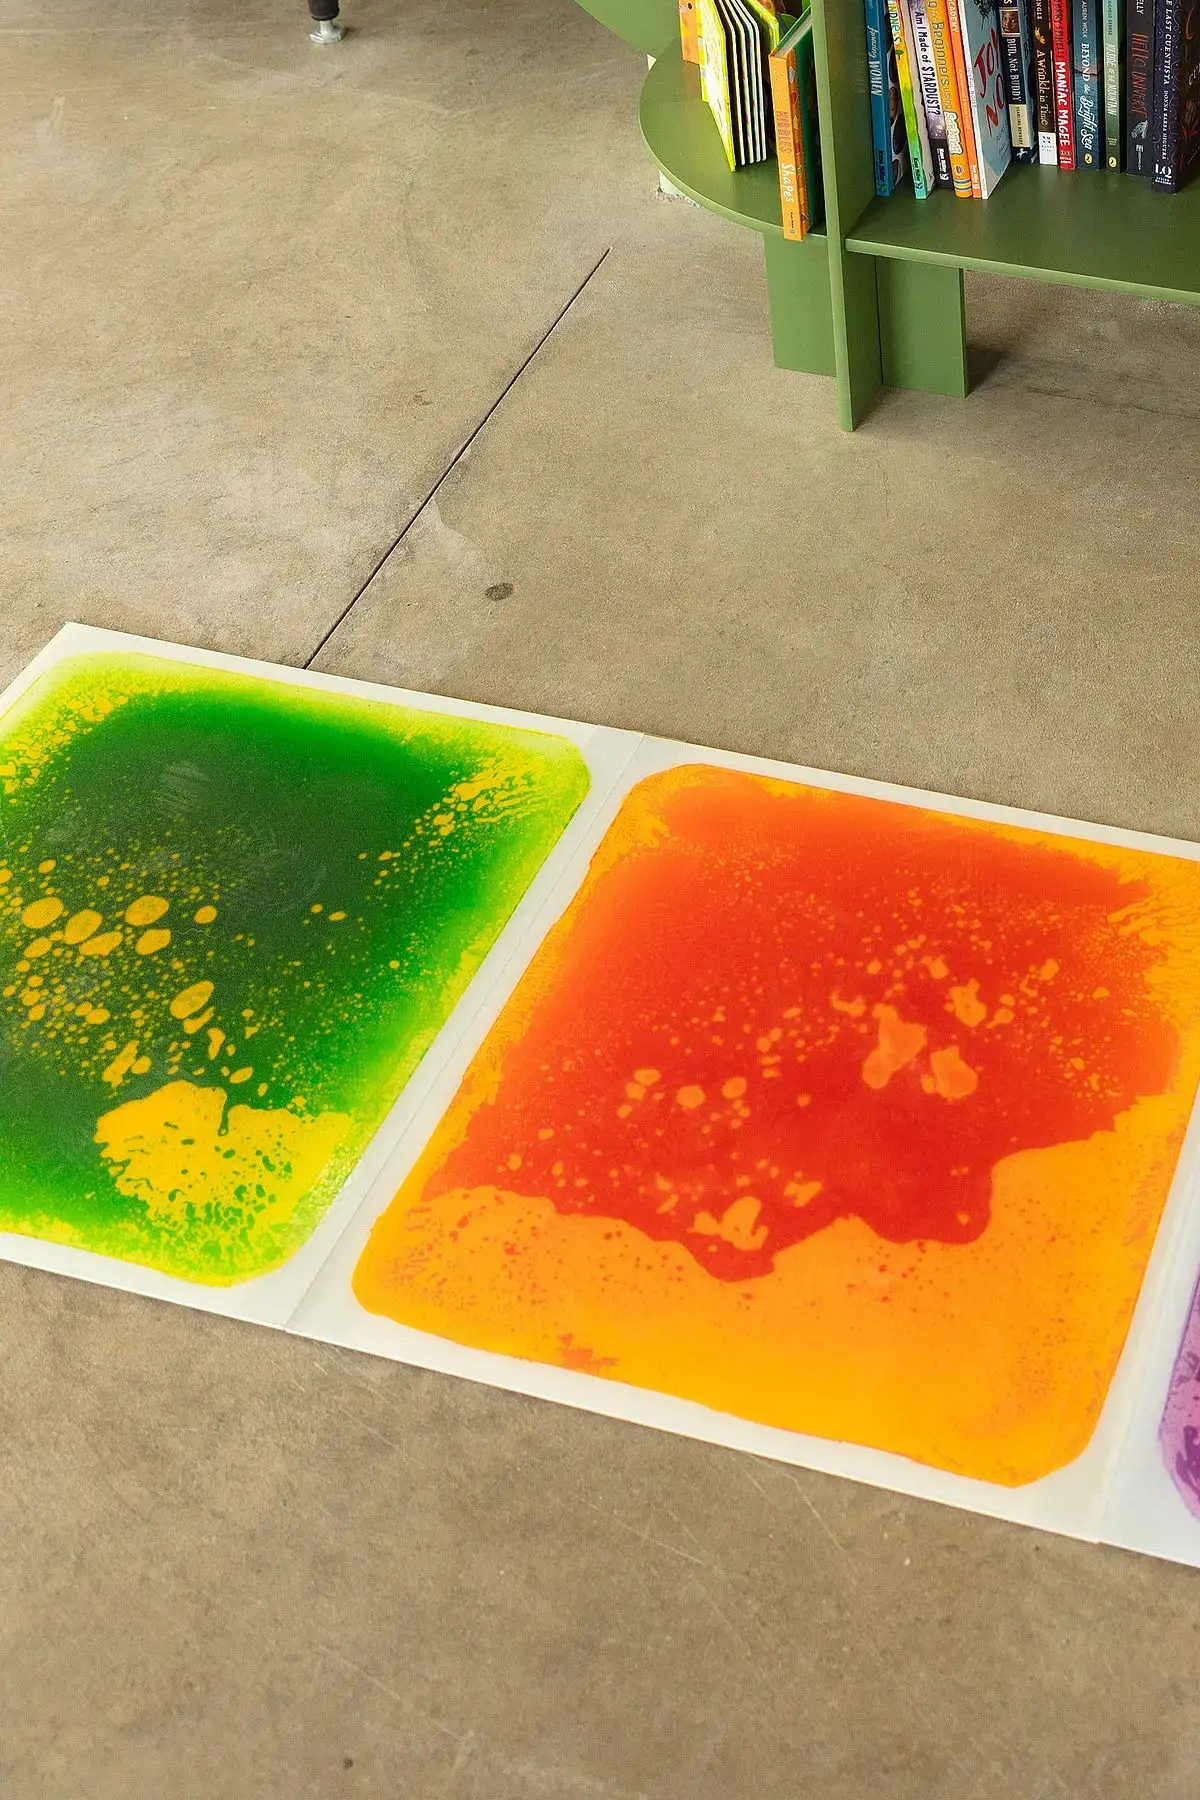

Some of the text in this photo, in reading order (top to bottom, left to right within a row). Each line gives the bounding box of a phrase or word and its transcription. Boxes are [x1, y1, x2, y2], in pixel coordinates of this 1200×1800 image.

[914, 10, 924, 21] Am
[917, 28, 929, 51] Made
[1036, 49, 1046, 58] A
[920, 53, 930, 63] of
[1007, 58, 1018, 72] Not
[1081, 43, 1090, 80] BEYOND
[1163, 33, 1171, 84] CUENTISTA
[921, 65, 939, 115] STARDUST?
[1009, 74, 1021, 102] BUDDY
[1037, 59, 1049, 93] Wrinkle
[1039, 106, 1049, 125] Time
[1077, 96, 1096, 128] Bright
[1057, 109, 1070, 146] MAGEE
[1081, 130, 1094, 150] Sea
[779, 161, 797, 202] Shapes
